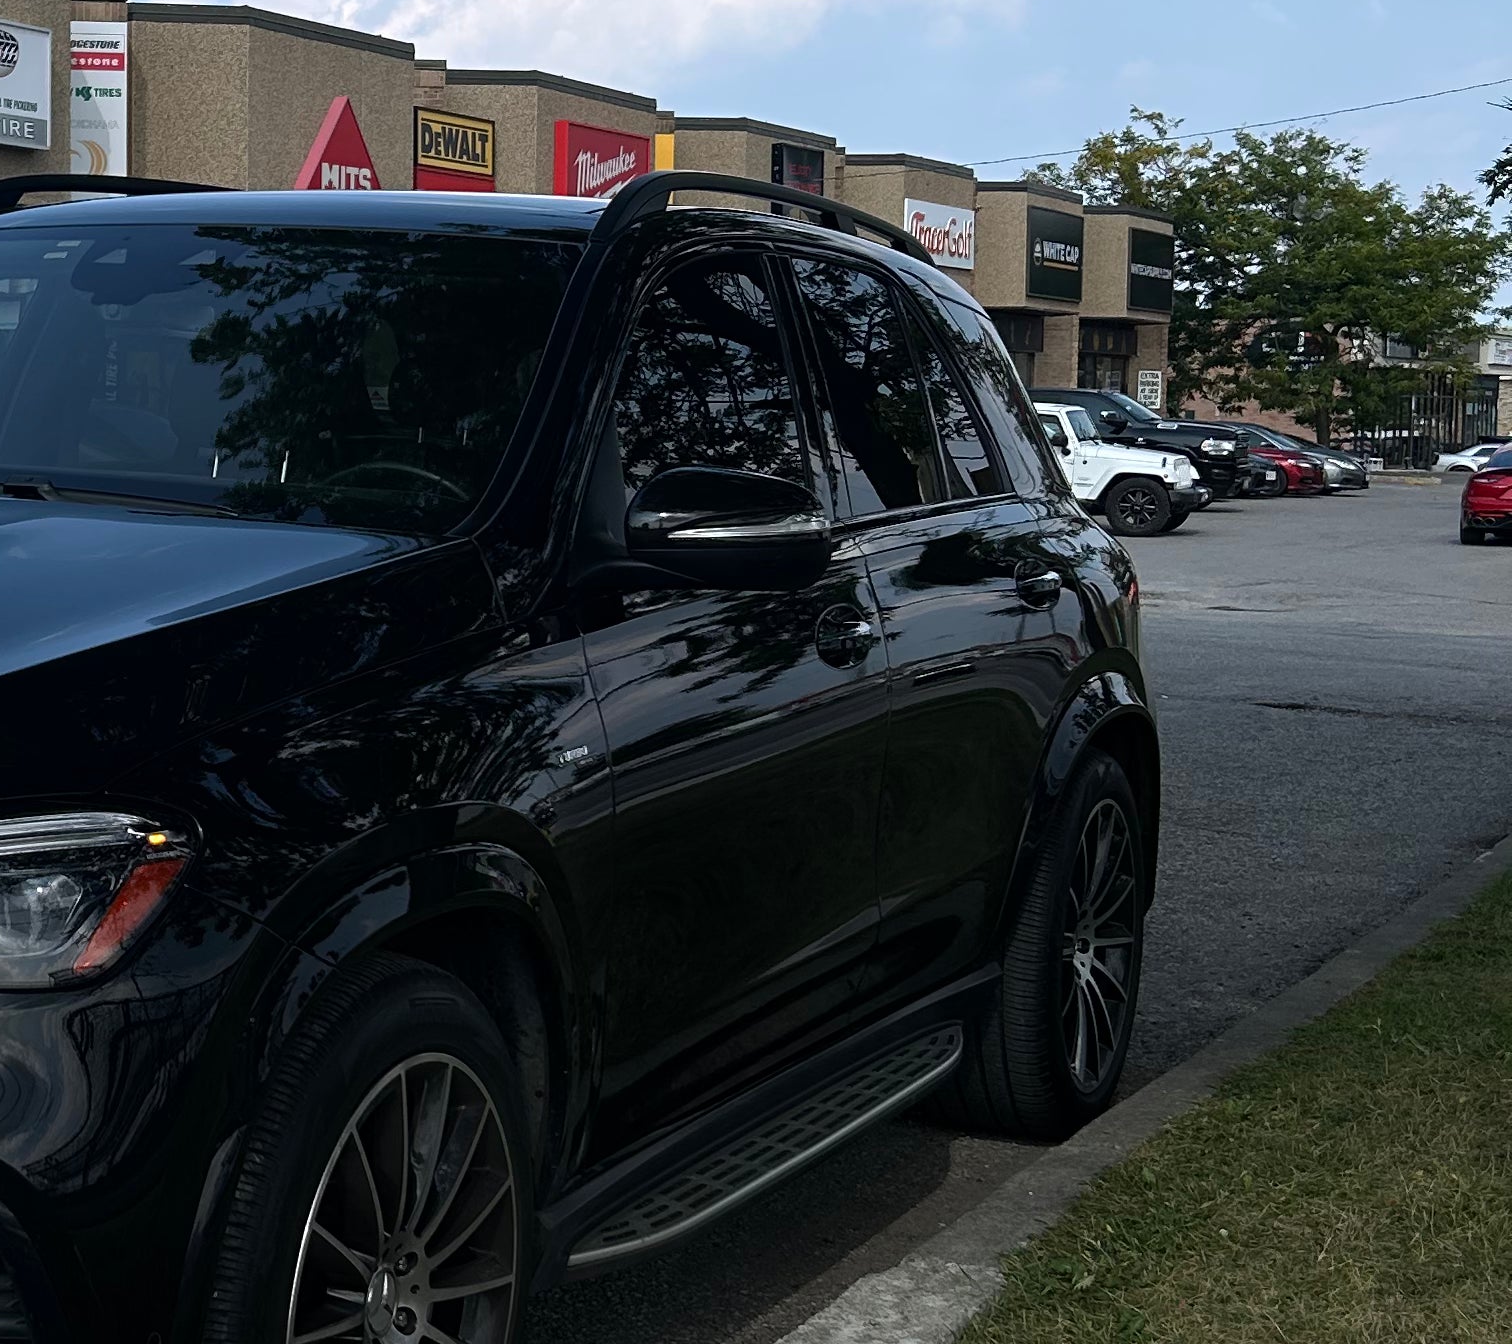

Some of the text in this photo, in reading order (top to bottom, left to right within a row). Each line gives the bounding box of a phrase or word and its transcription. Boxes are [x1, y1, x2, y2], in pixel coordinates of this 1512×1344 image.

[94, 88, 122, 98] TIRES
[321, 162, 371, 190] MITS
[573, 145, 637, 197] Milwaukee
[1042, 240, 1079, 263] WHITE CAP
